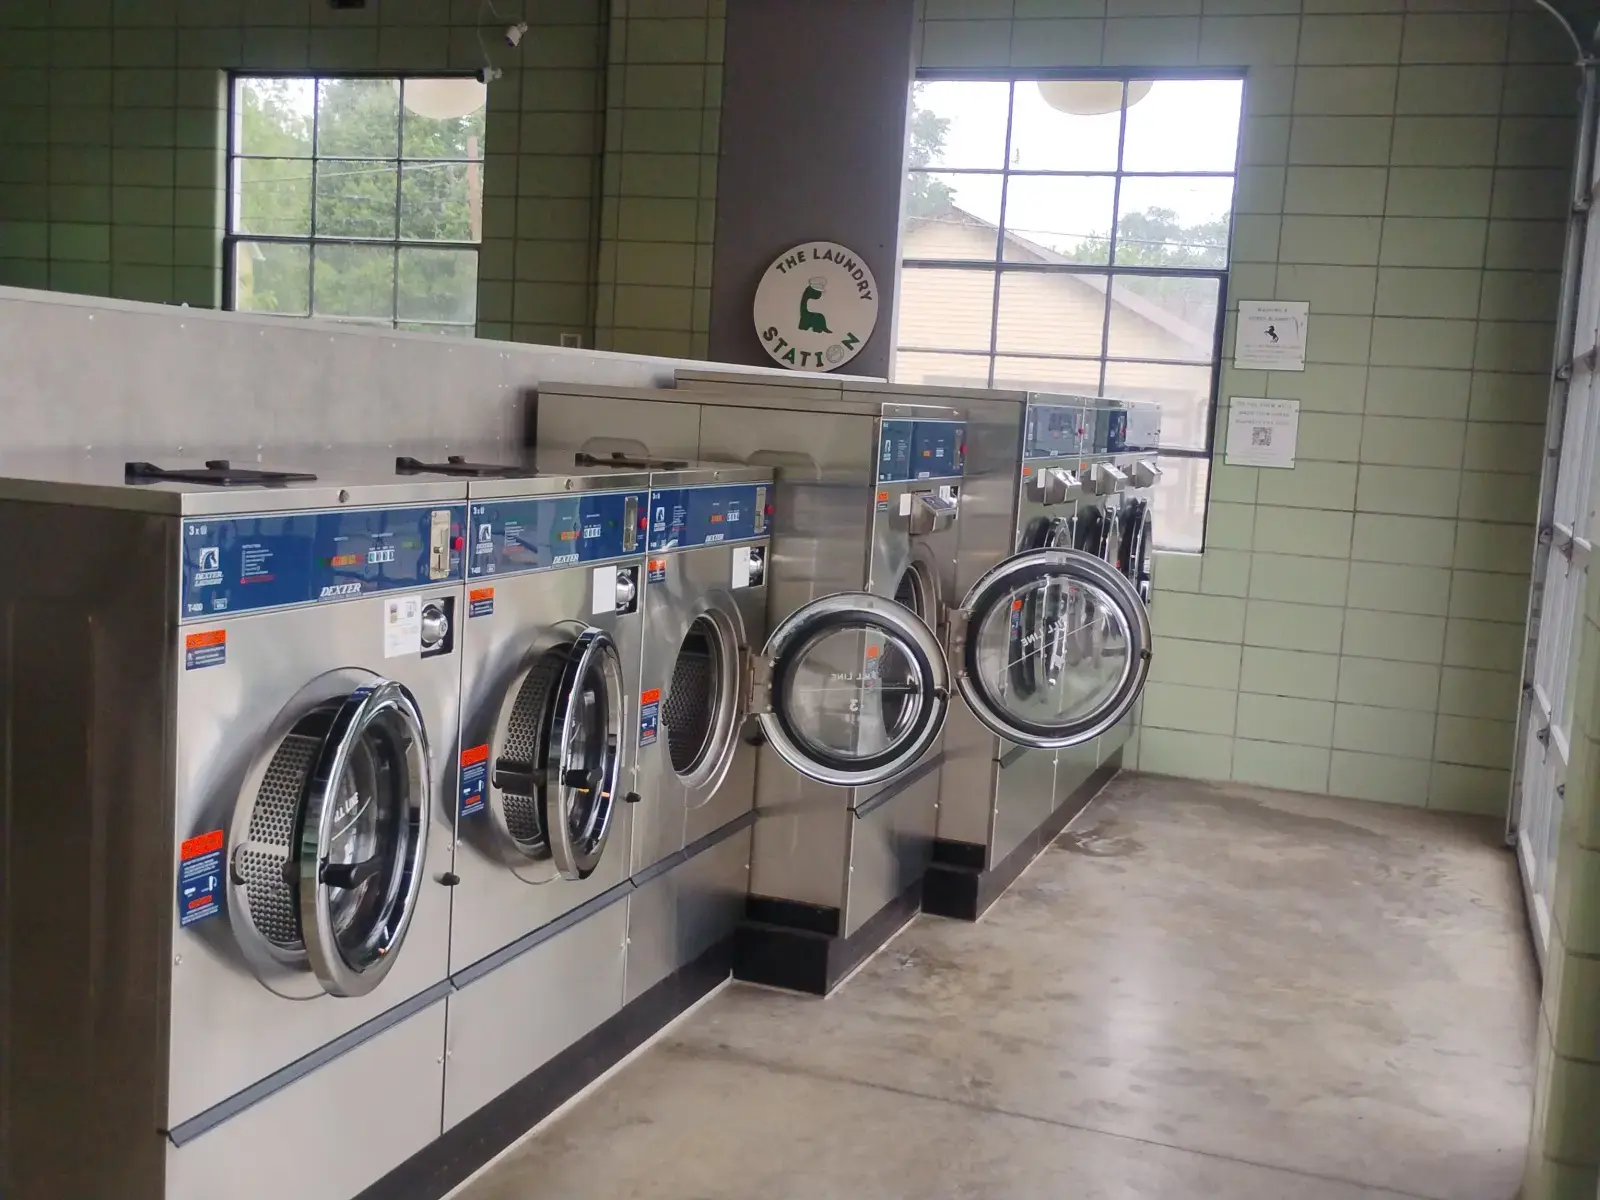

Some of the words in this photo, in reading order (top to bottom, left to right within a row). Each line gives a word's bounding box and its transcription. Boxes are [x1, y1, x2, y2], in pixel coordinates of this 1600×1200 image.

[776, 251, 806, 274] THE
[813, 248, 872, 301] LAUNDRY
[320, 582, 362, 597] DEXTER
